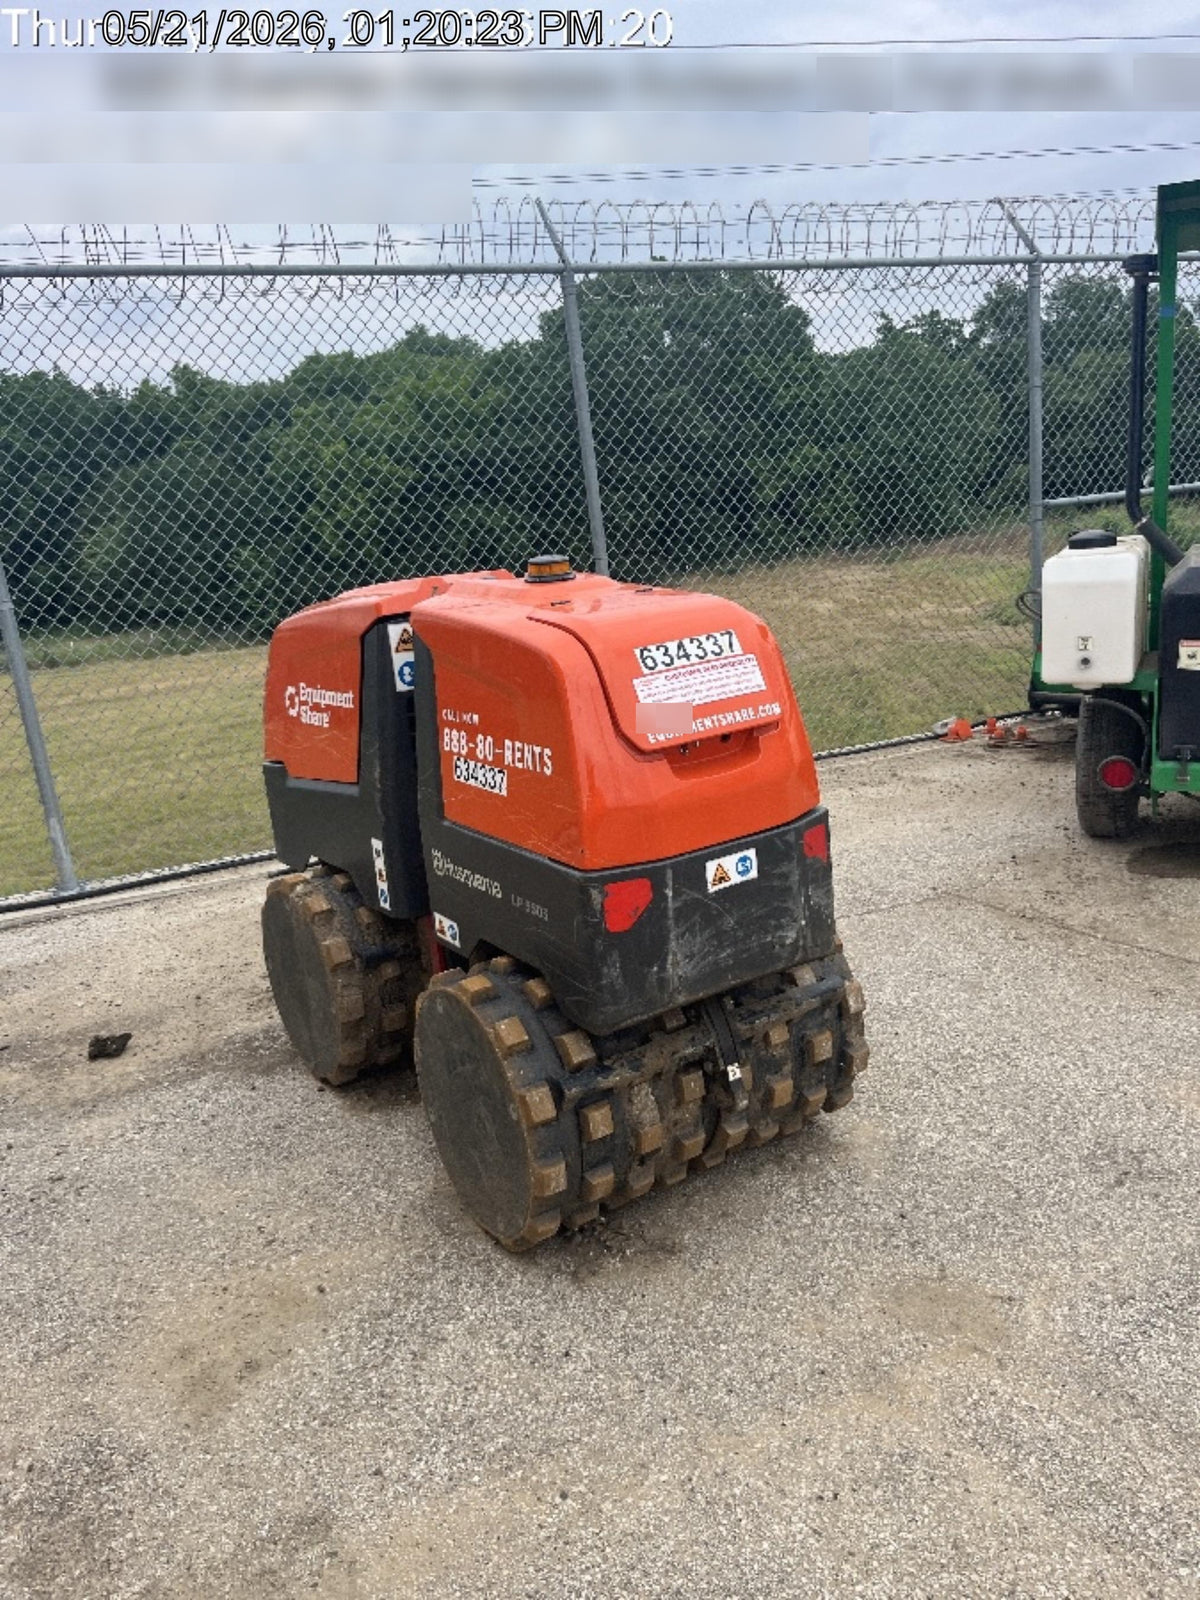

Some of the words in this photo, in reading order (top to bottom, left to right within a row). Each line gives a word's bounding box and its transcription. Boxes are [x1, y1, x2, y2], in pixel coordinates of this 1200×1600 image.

[639, 630, 735, 670] 634337
[298, 682, 355, 708] Equipment
[299, 705, 330, 728] Share
[647, 703, 782, 744] EQUMENTSHARE.COM
[443, 727, 552, 777] 888-80-RENTS
[454, 756, 506, 793] 634337
